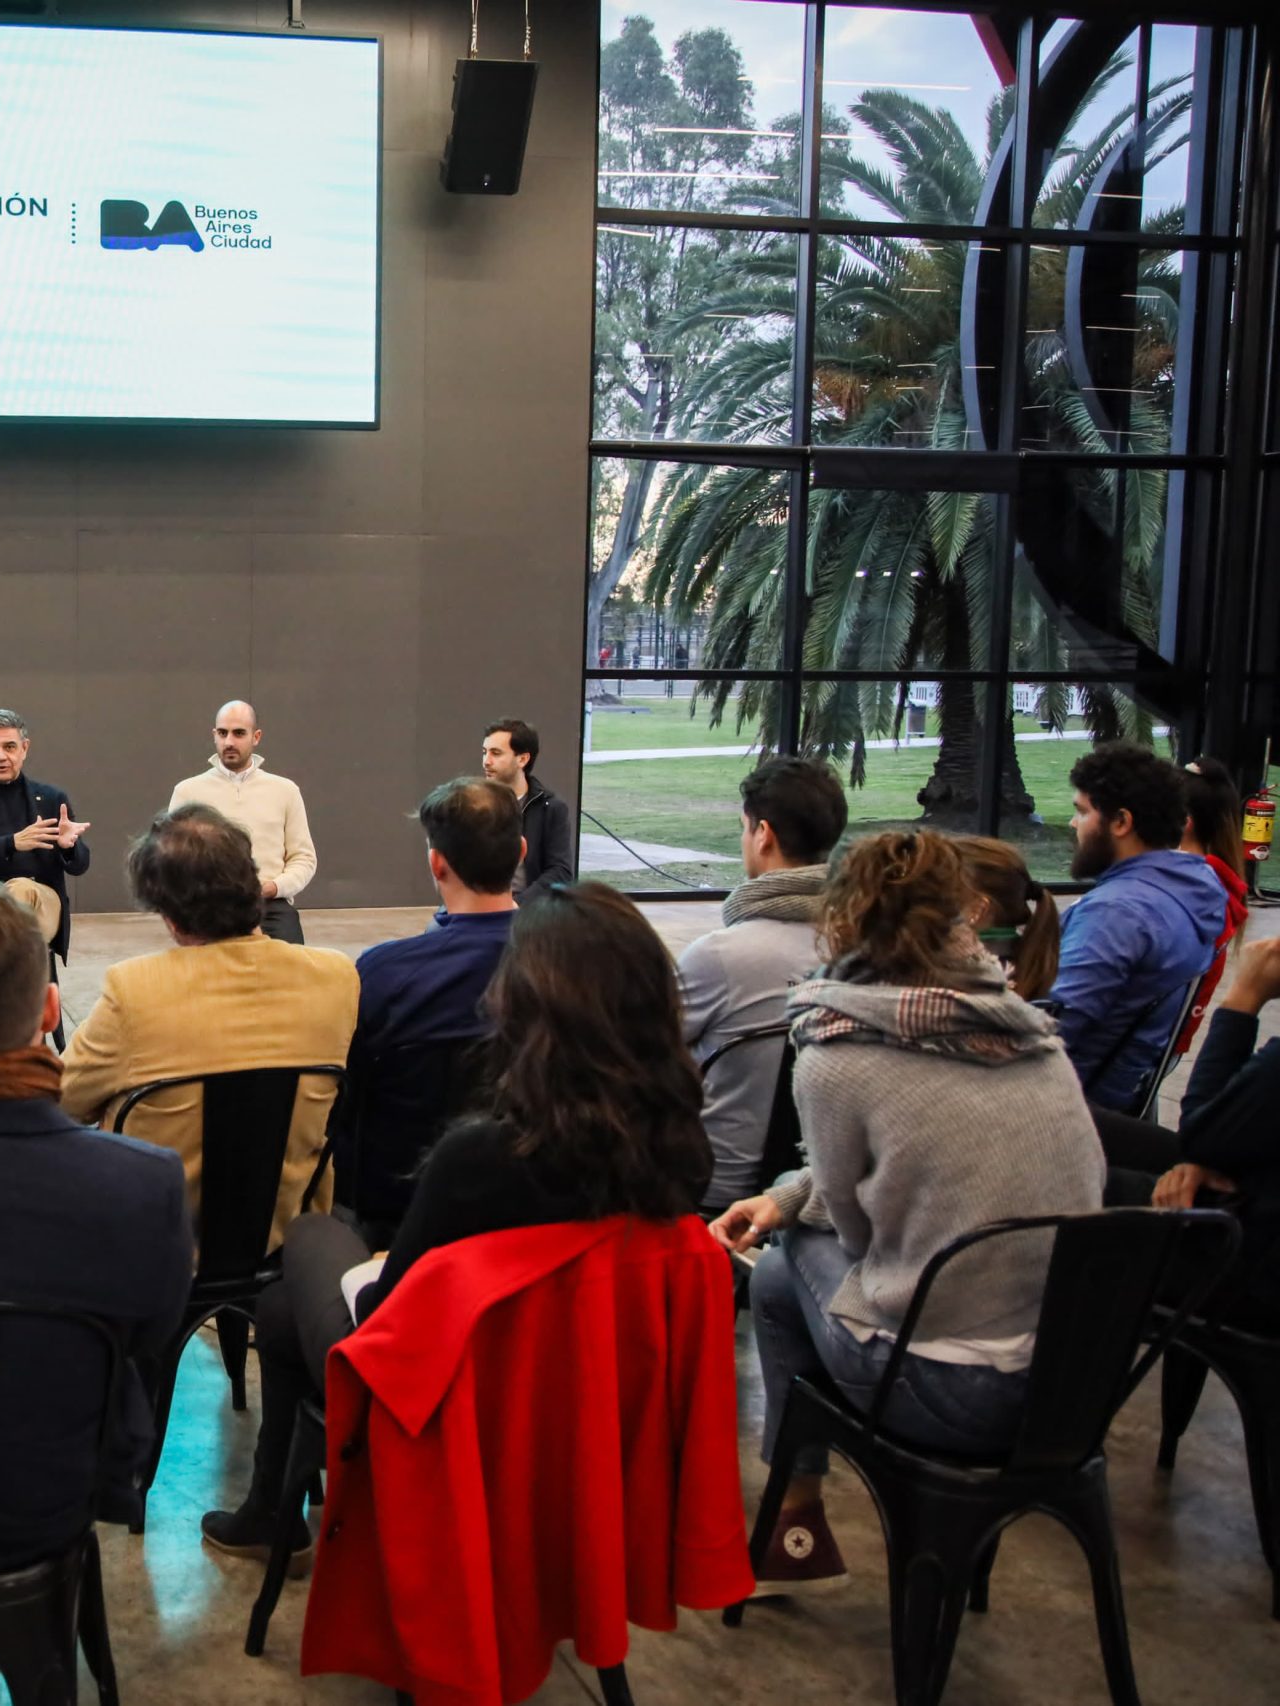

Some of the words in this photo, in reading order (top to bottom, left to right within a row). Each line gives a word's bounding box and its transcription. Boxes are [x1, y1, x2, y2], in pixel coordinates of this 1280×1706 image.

[194, 205, 258, 220] Buenos
[205, 220, 252, 234] Aires
[210, 234, 272, 249] Ciudad
